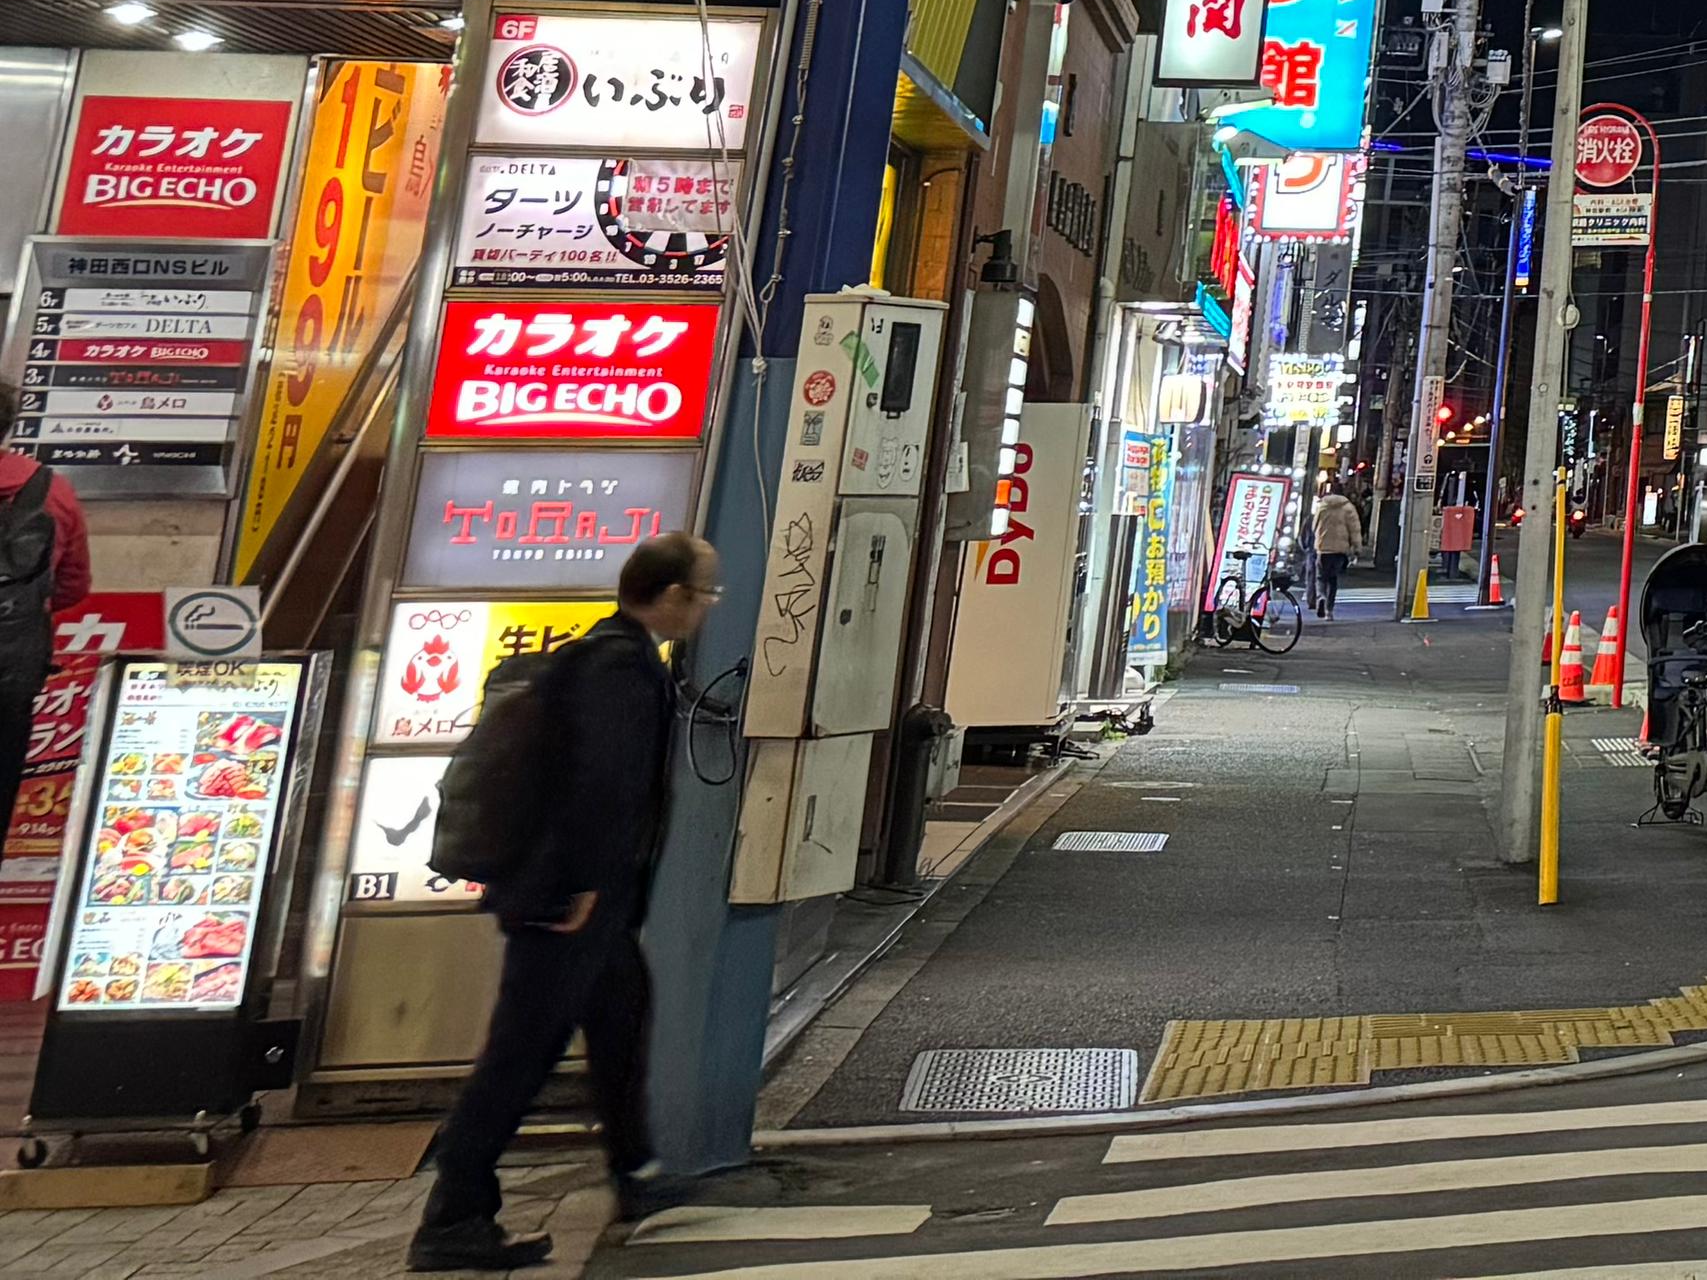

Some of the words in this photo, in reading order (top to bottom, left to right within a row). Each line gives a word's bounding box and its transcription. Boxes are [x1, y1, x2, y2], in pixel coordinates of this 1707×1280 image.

[501, 20, 535, 39] 6F
[581, 68, 726, 116] いぶり
[91, 125, 264, 158] カラオケ
[1576, 137, 1636, 165] 消火栓
[475, 223, 593, 241] ノーチャージ
[68, 257, 230, 277] 神田西口NSビル
[145, 318, 213, 334] DELTA
[466, 313, 689, 357] カラオケ
[83, 344, 147, 359] カラオケ
[484, 364, 547, 378] Karaoke
[552, 365, 664, 379] Entertainment
[456, 380, 548, 422] BIG
[560, 382, 683, 423] ECHO
[443, 499, 661, 544] TORAJI
[356, 873, 392, 899] B1
